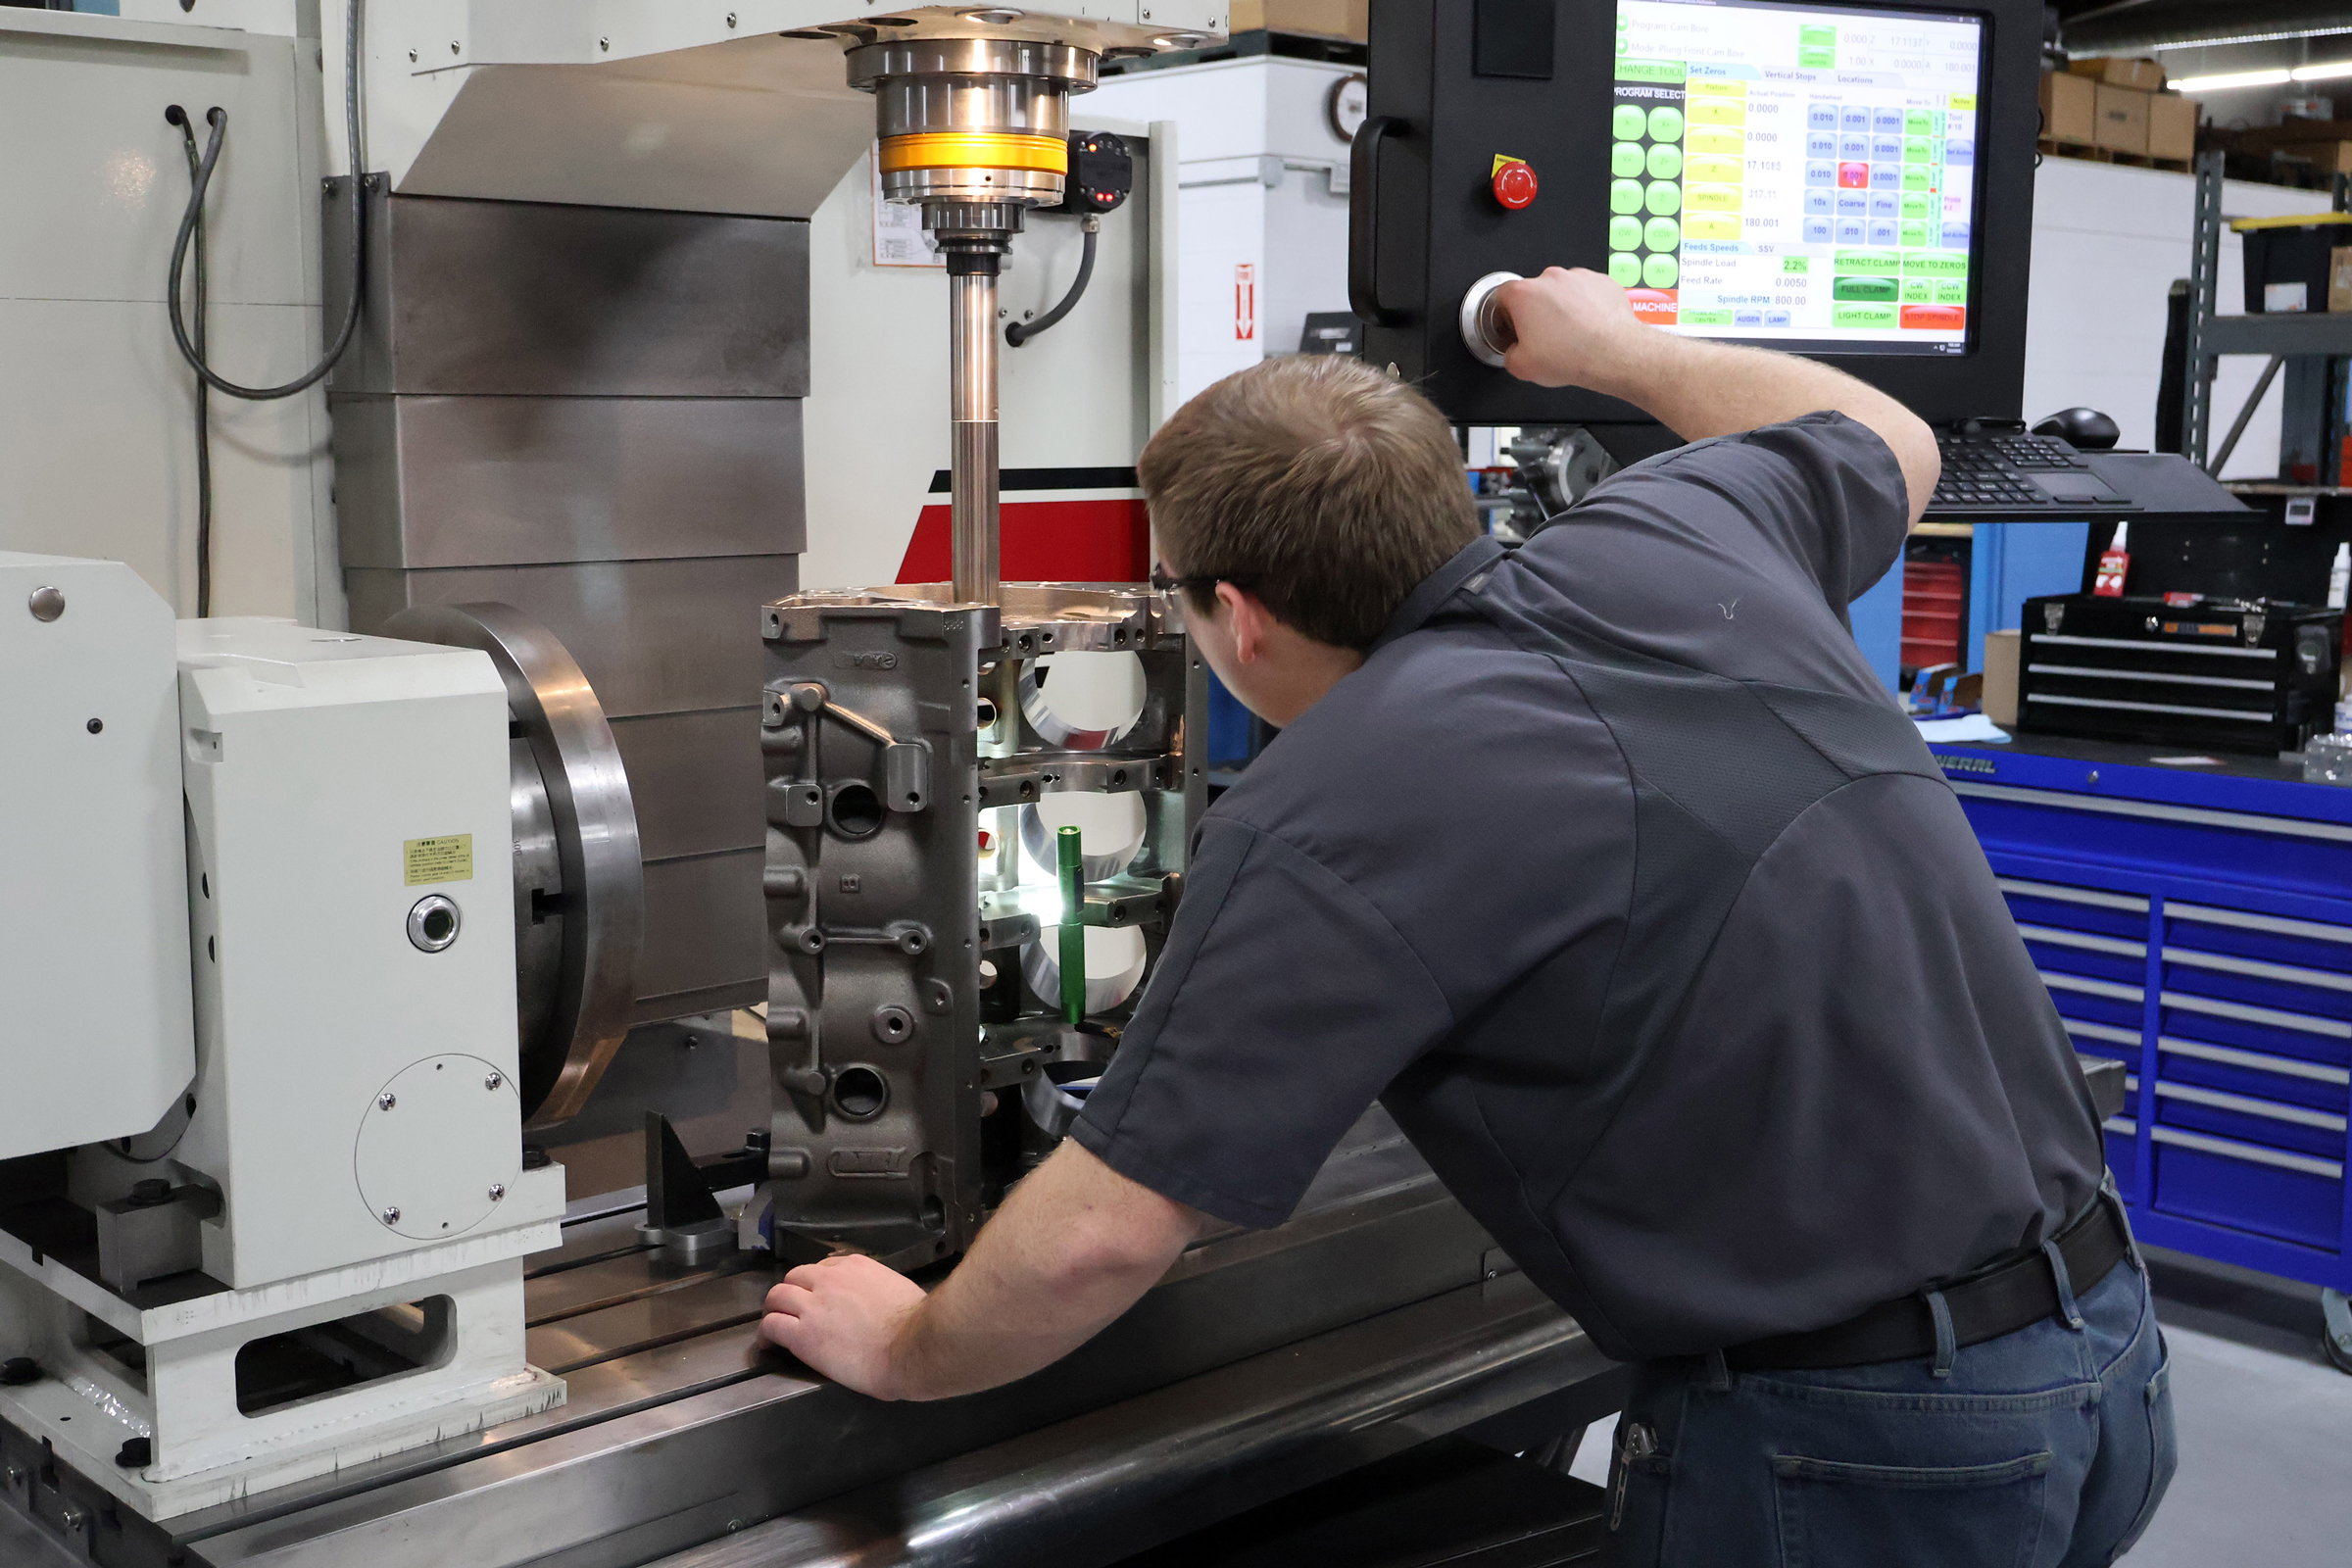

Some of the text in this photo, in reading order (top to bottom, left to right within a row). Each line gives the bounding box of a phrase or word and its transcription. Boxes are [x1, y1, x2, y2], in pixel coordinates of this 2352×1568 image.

[1632, 20, 1709, 33] Program: Cam Bore
[1843, 33, 1867, 44] 0.000
[1631, 43, 1745, 58] Mode: Plung Front Cam Bore
[1949, 41, 1978, 52] 0.0000
[1849, 56, 1866, 67] 1.00
[1893, 59, 1922, 70] 0.0000
[1659, 66, 1686, 77] TOOL
[1690, 66, 1727, 76] Set Zeros
[1945, 62, 1976, 74] 180.001
[1765, 70, 1817, 82] Vertical Stops
[1838, 74, 1874, 85] Locations
[1654, 89, 1686, 100] SELECT
[1748, 103, 1779, 114] 0.0000
[1813, 113, 1834, 122] 0.010
[1845, 115, 1866, 123] 0.001
[1876, 117, 1899, 125] 0.0001
[1747, 131, 1778, 142] 0.0000
[1812, 141, 1833, 150] 0.010
[1844, 143, 1864, 152] 0.001
[1875, 144, 1898, 153] 0.0001
[1810, 170, 1832, 178] 0.010
[1843, 171, 1863, 179] 0.001
[1873, 172, 1897, 181] 0.0001
[1697, 193, 1729, 202] SPINDLE
[1813, 198, 1827, 207] 10x
[1838, 199, 1866, 208] Coarse
[1745, 218, 1779, 227] 180.001
[1684, 242, 1739, 253] Feeds Speeds
[1682, 257, 1807, 271] Spindle Load 2.2%
[1835, 258, 1901, 268] RETRACT CLAMP
[1681, 275, 1807, 288] Feed Rate 0.0050
[1863, 285, 1890, 294] CLAMP
[1717, 295, 1806, 306] Spindle RPM 800.00
[1633, 302, 1677, 313] MACHINE
[1864, 312, 1891, 320] CLAMP
